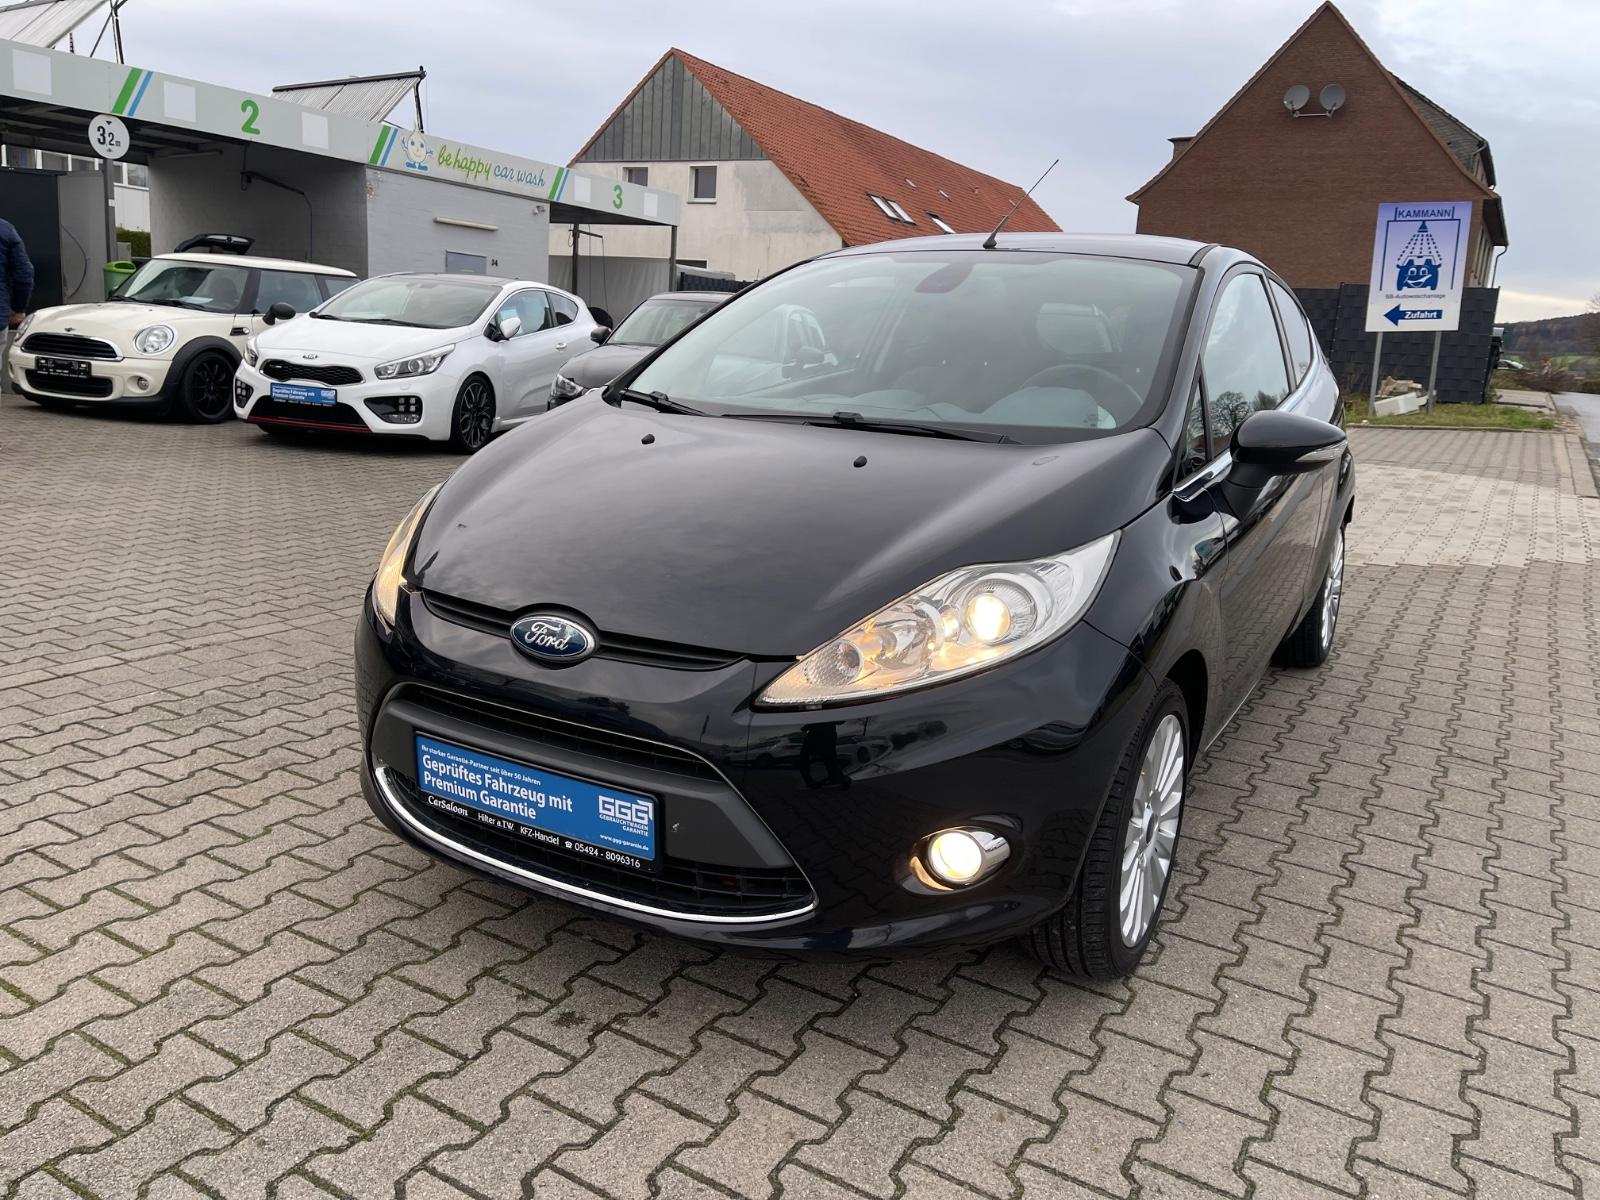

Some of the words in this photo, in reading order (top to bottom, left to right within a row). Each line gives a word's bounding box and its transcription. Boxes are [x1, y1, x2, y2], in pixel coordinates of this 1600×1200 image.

[240, 99, 260, 135] 2
[437, 144, 452, 167] be
[452, 148, 492, 181] happy
[494, 164, 514, 180] car
[516, 168, 545, 187] wash
[612, 184, 624, 209] 3
[1398, 209, 1451, 218] KAMMANN
[1404, 311, 1438, 319] Zufahrt
[524, 621, 572, 651] Ford
[421, 744, 429, 752] Ihr
[429, 748, 446, 758] starker
[446, 752, 489, 771] Garantie-Partner
[500, 768, 513, 778] über
[514, 772, 522, 780] 50
[522, 774, 541, 786] Jahren
[422, 754, 482, 786] Geprüftes
[484, 773, 545, 808] Fahrzeug
[549, 794, 573, 813] mit
[423, 771, 477, 801] Premium
[479, 790, 536, 819] Garantie
[598, 795, 649, 825] GGG
[599, 814, 648, 831] GEBRAUCHTWAGEN
[428, 795, 468, 816] CarSaloon
[478, 812, 495, 825] Hilter
[520, 826, 560, 845] KFZ-Handel
[574, 842, 599, 857] 05424
[605, 851, 641, 868] 8096316
[600, 834, 649, 851] www.ggg-garantie.de
[622, 825, 648, 837] GARANTIE
